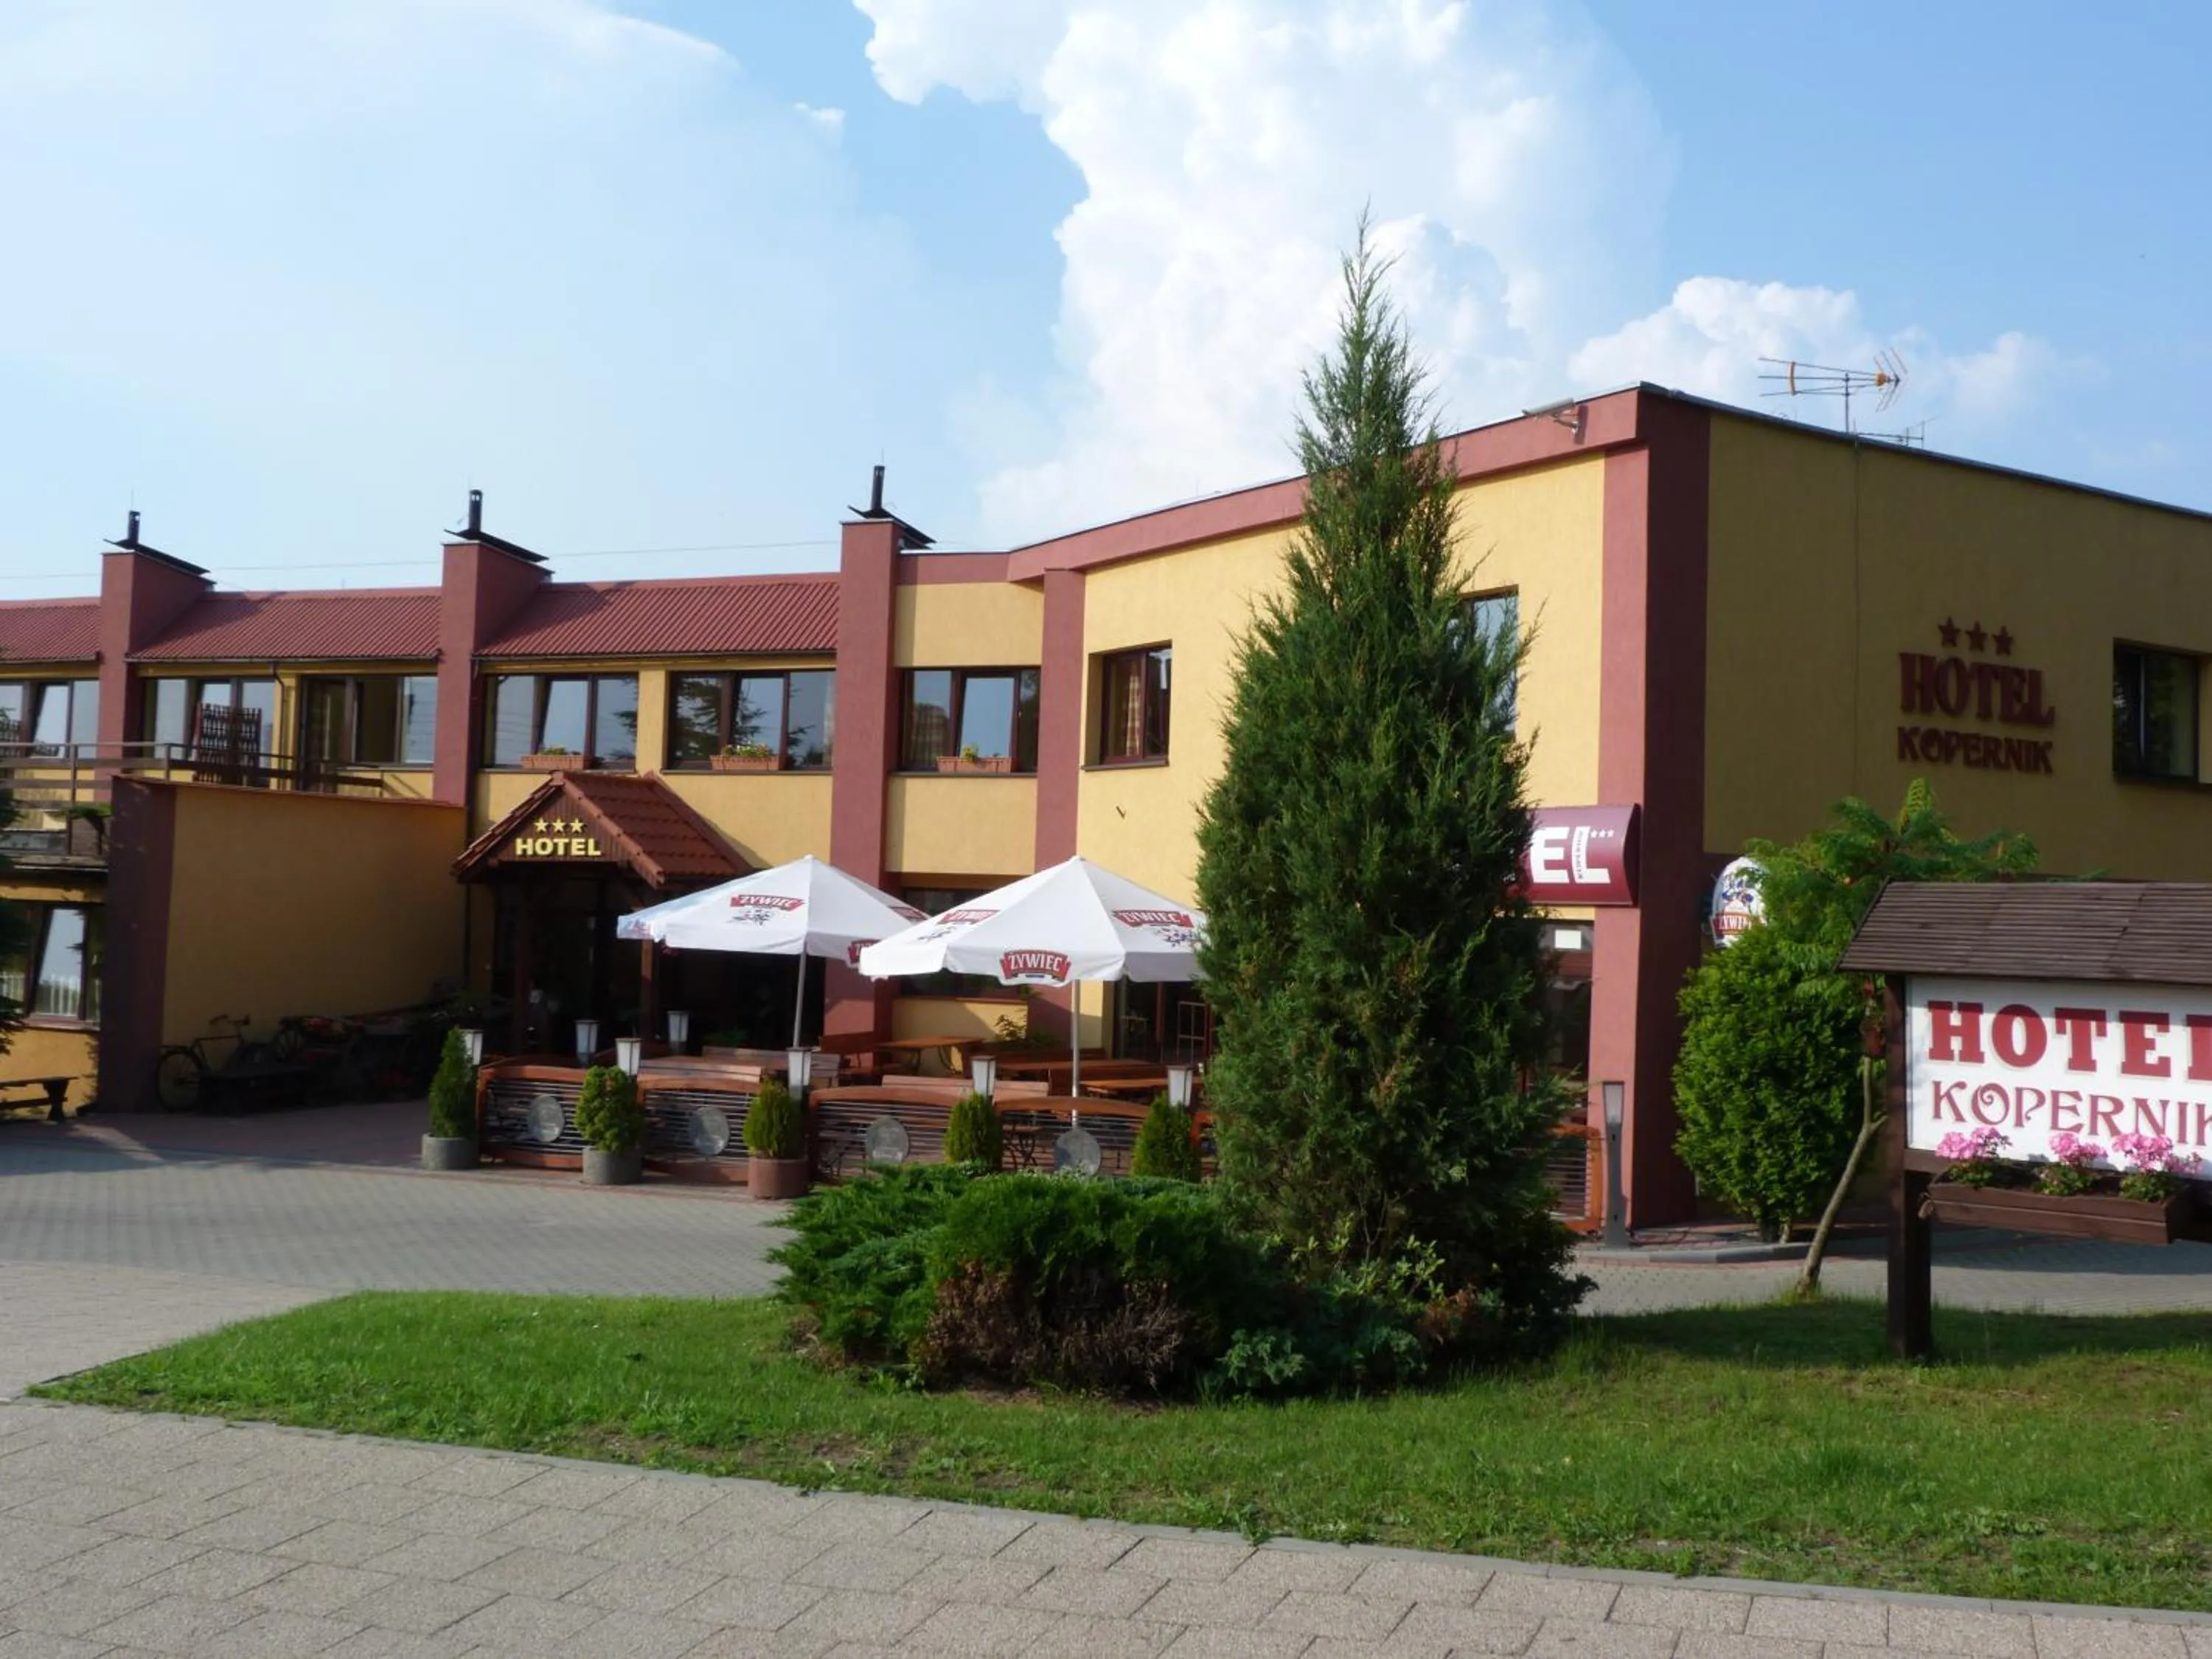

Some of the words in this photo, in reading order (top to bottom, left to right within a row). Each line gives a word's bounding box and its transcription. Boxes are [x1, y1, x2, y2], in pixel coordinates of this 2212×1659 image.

[1898, 652, 2056, 726] HOTEL
[1897, 726, 2053, 774] KOPERNIK
[515, 838, 602, 857] HOTEL
[1530, 826, 1611, 884] EL
